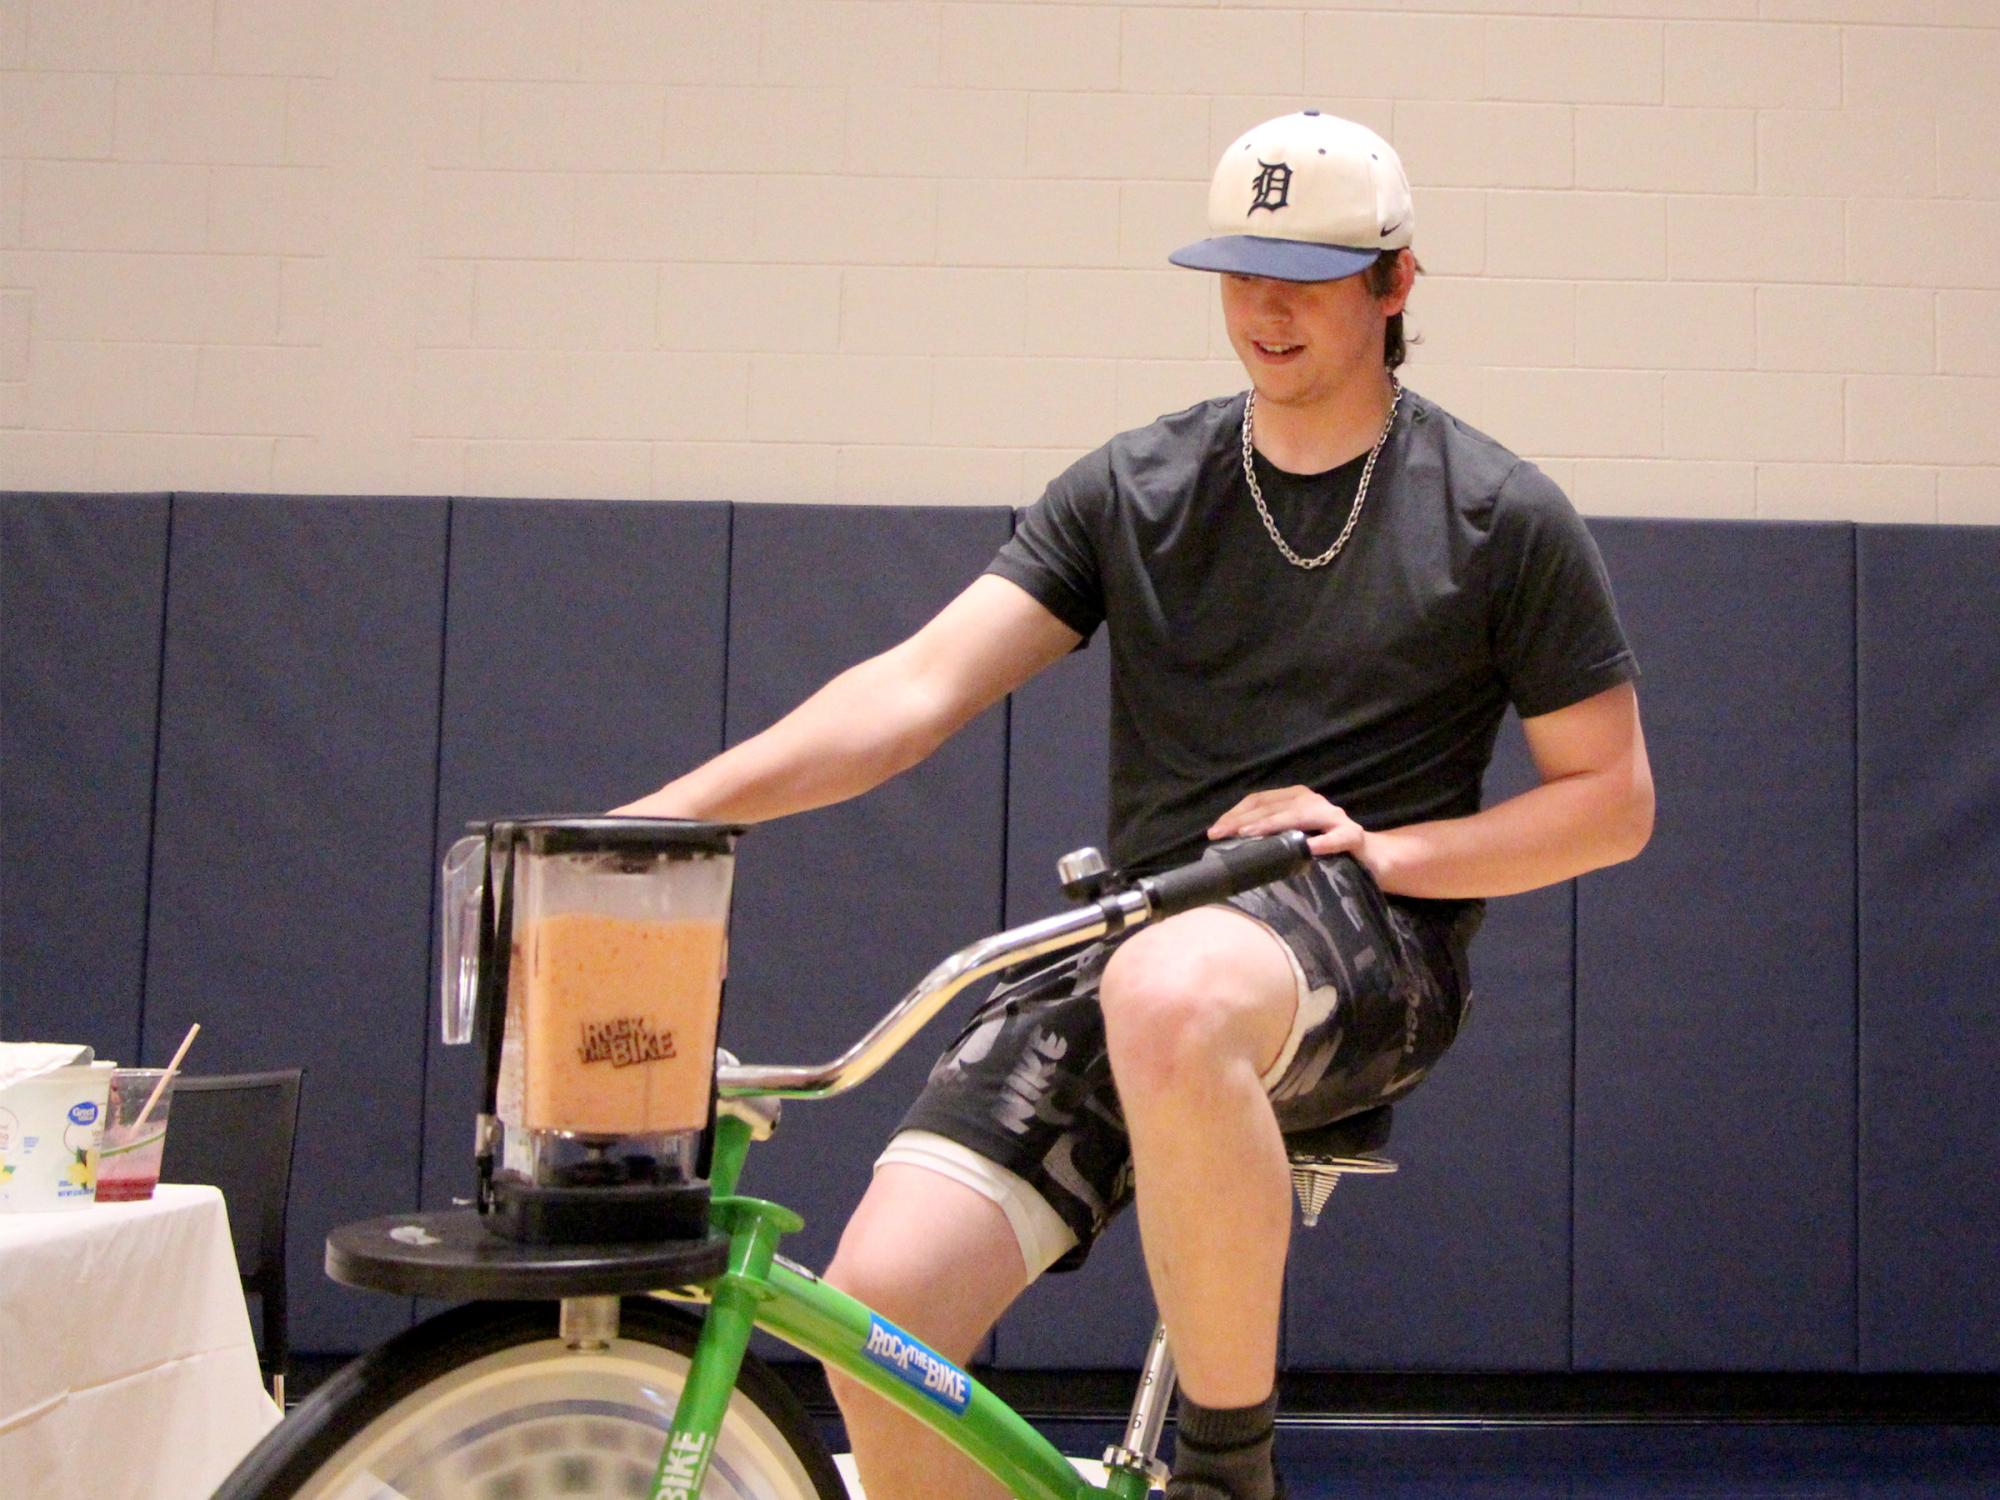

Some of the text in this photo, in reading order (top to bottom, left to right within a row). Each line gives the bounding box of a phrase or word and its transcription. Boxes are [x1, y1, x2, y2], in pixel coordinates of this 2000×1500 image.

[1247, 158, 1293, 217] D
[867, 1322, 909, 1370] ROCK
[924, 1357, 966, 1403] BIKE
